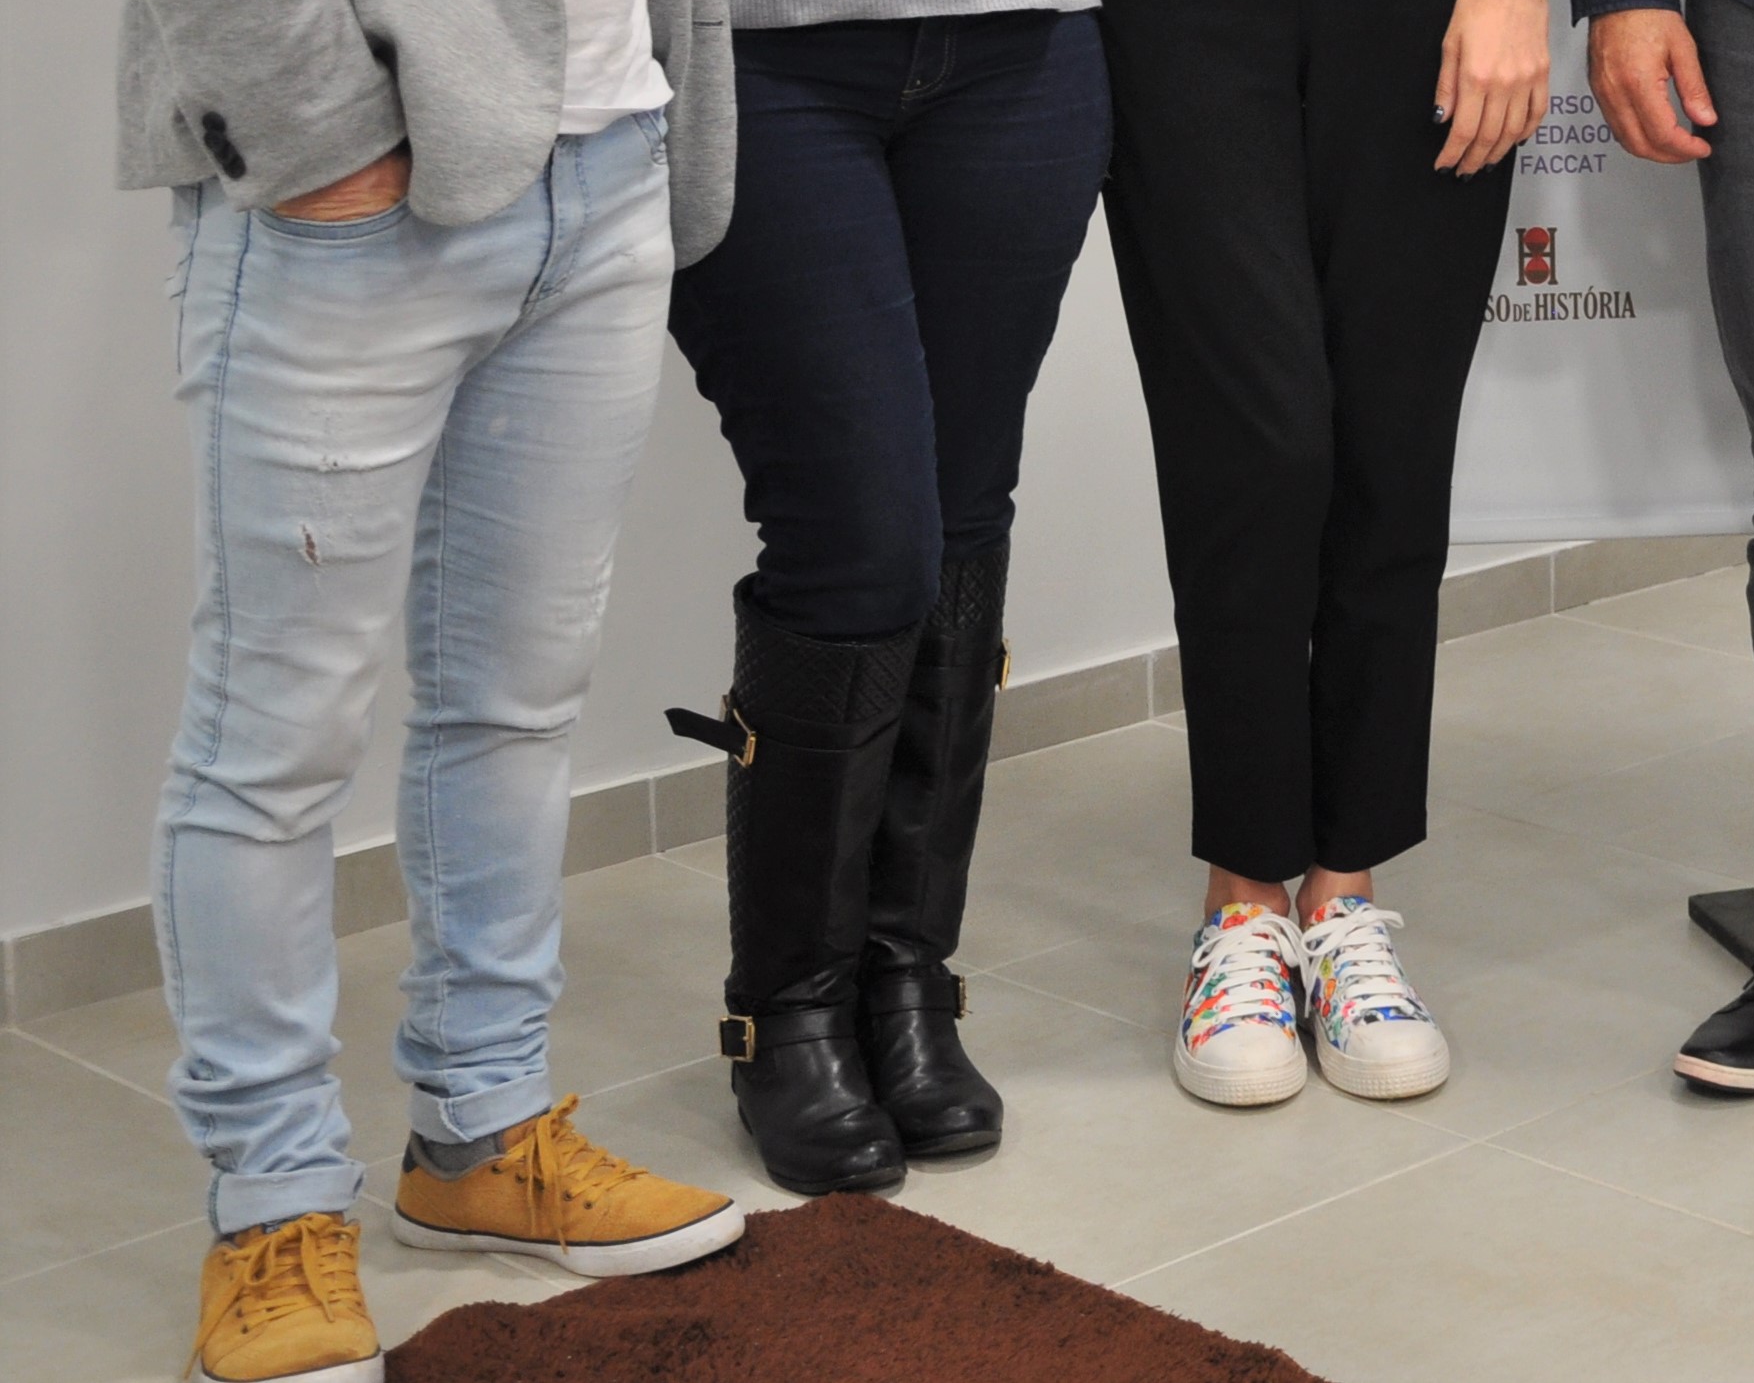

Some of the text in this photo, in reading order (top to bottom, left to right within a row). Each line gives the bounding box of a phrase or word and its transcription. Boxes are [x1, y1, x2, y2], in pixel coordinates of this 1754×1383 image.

[1549, 95, 1594, 115] RSO
[1535, 124, 1611, 145] EDAGO
[1520, 154, 1607, 174] FACCAT
[1513, 303, 1531, 322] DE
[1534, 285, 1636, 321] HISTÓRIA
